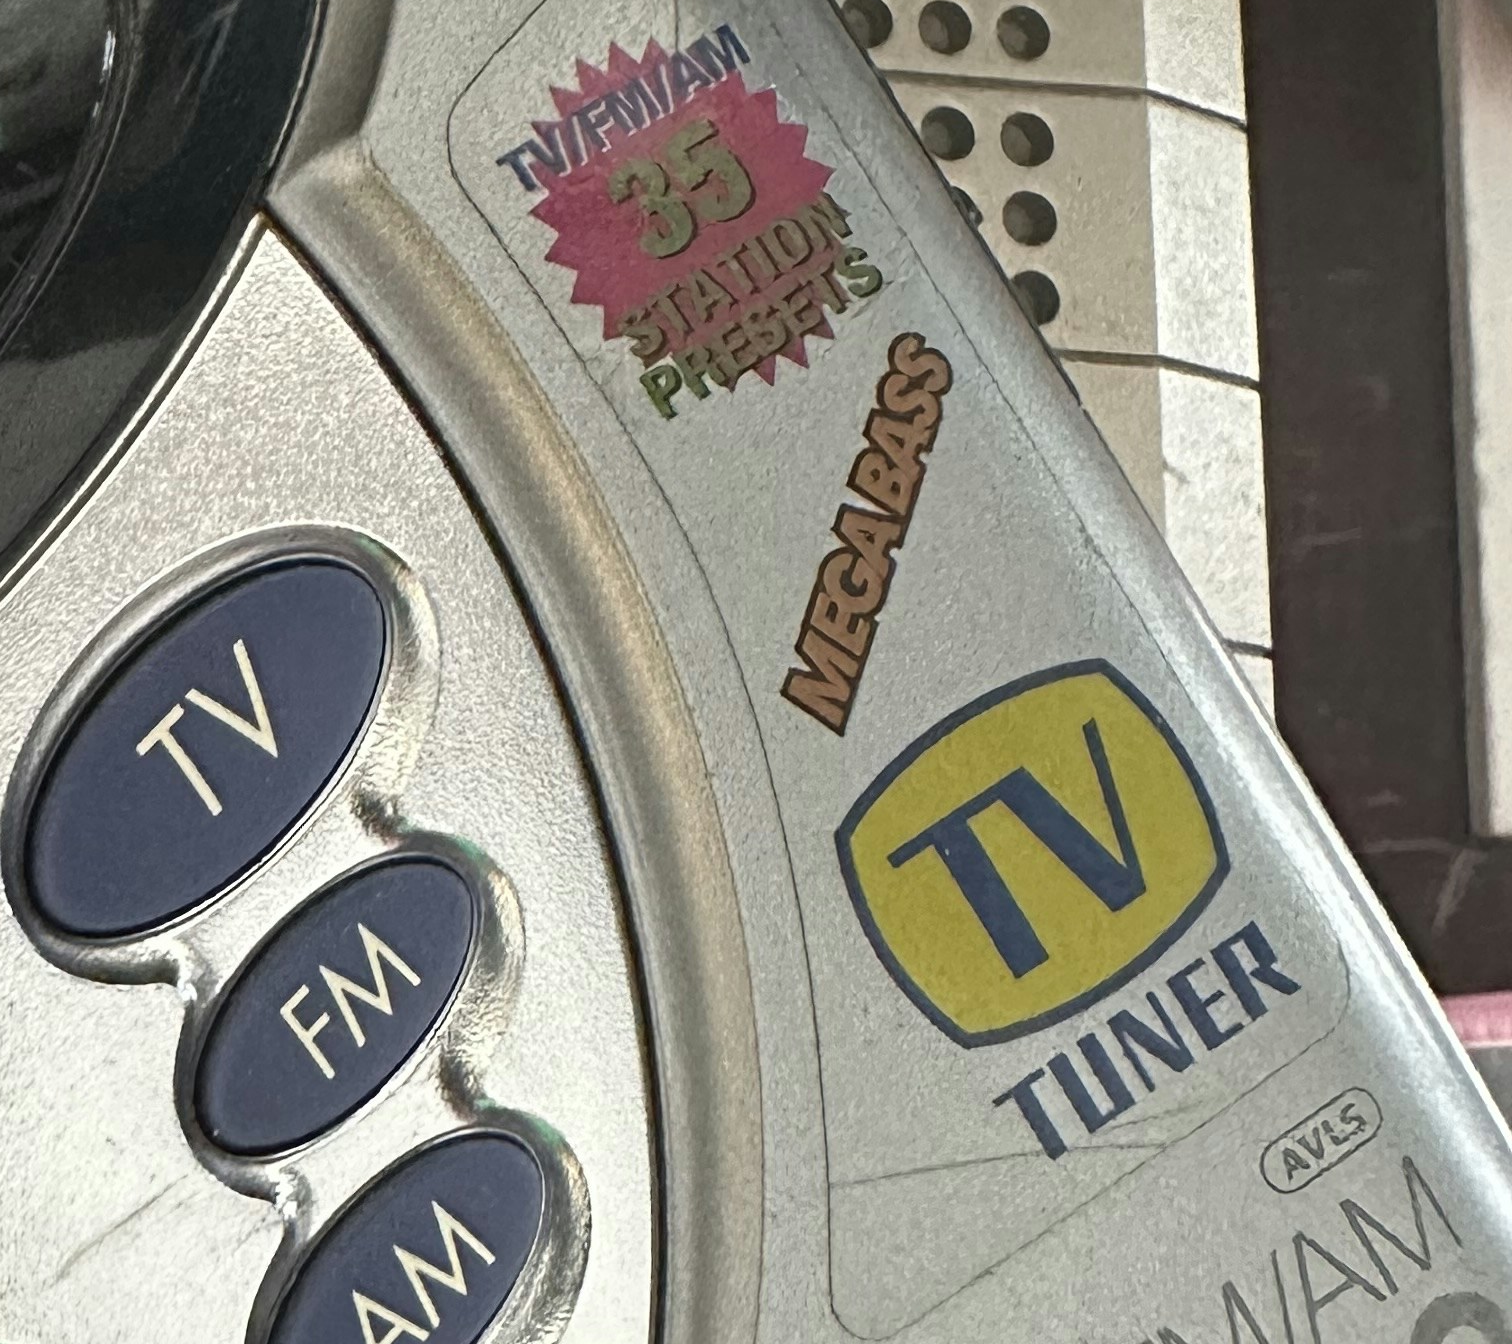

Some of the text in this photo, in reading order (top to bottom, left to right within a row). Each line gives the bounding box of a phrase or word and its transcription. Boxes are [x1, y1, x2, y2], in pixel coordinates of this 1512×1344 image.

[495, 24, 752, 193] TV/FM/AM
[609, 117, 757, 260] 35
[617, 191, 853, 370] STATION
[639, 246, 884, 421] PRESETS
[135, 638, 278, 817] TV
[887, 717, 1147, 979] TV
[279, 922, 422, 1080] FM
[991, 920, 1302, 1160] TUNER
[1280, 1102, 1367, 1180] AVLS
